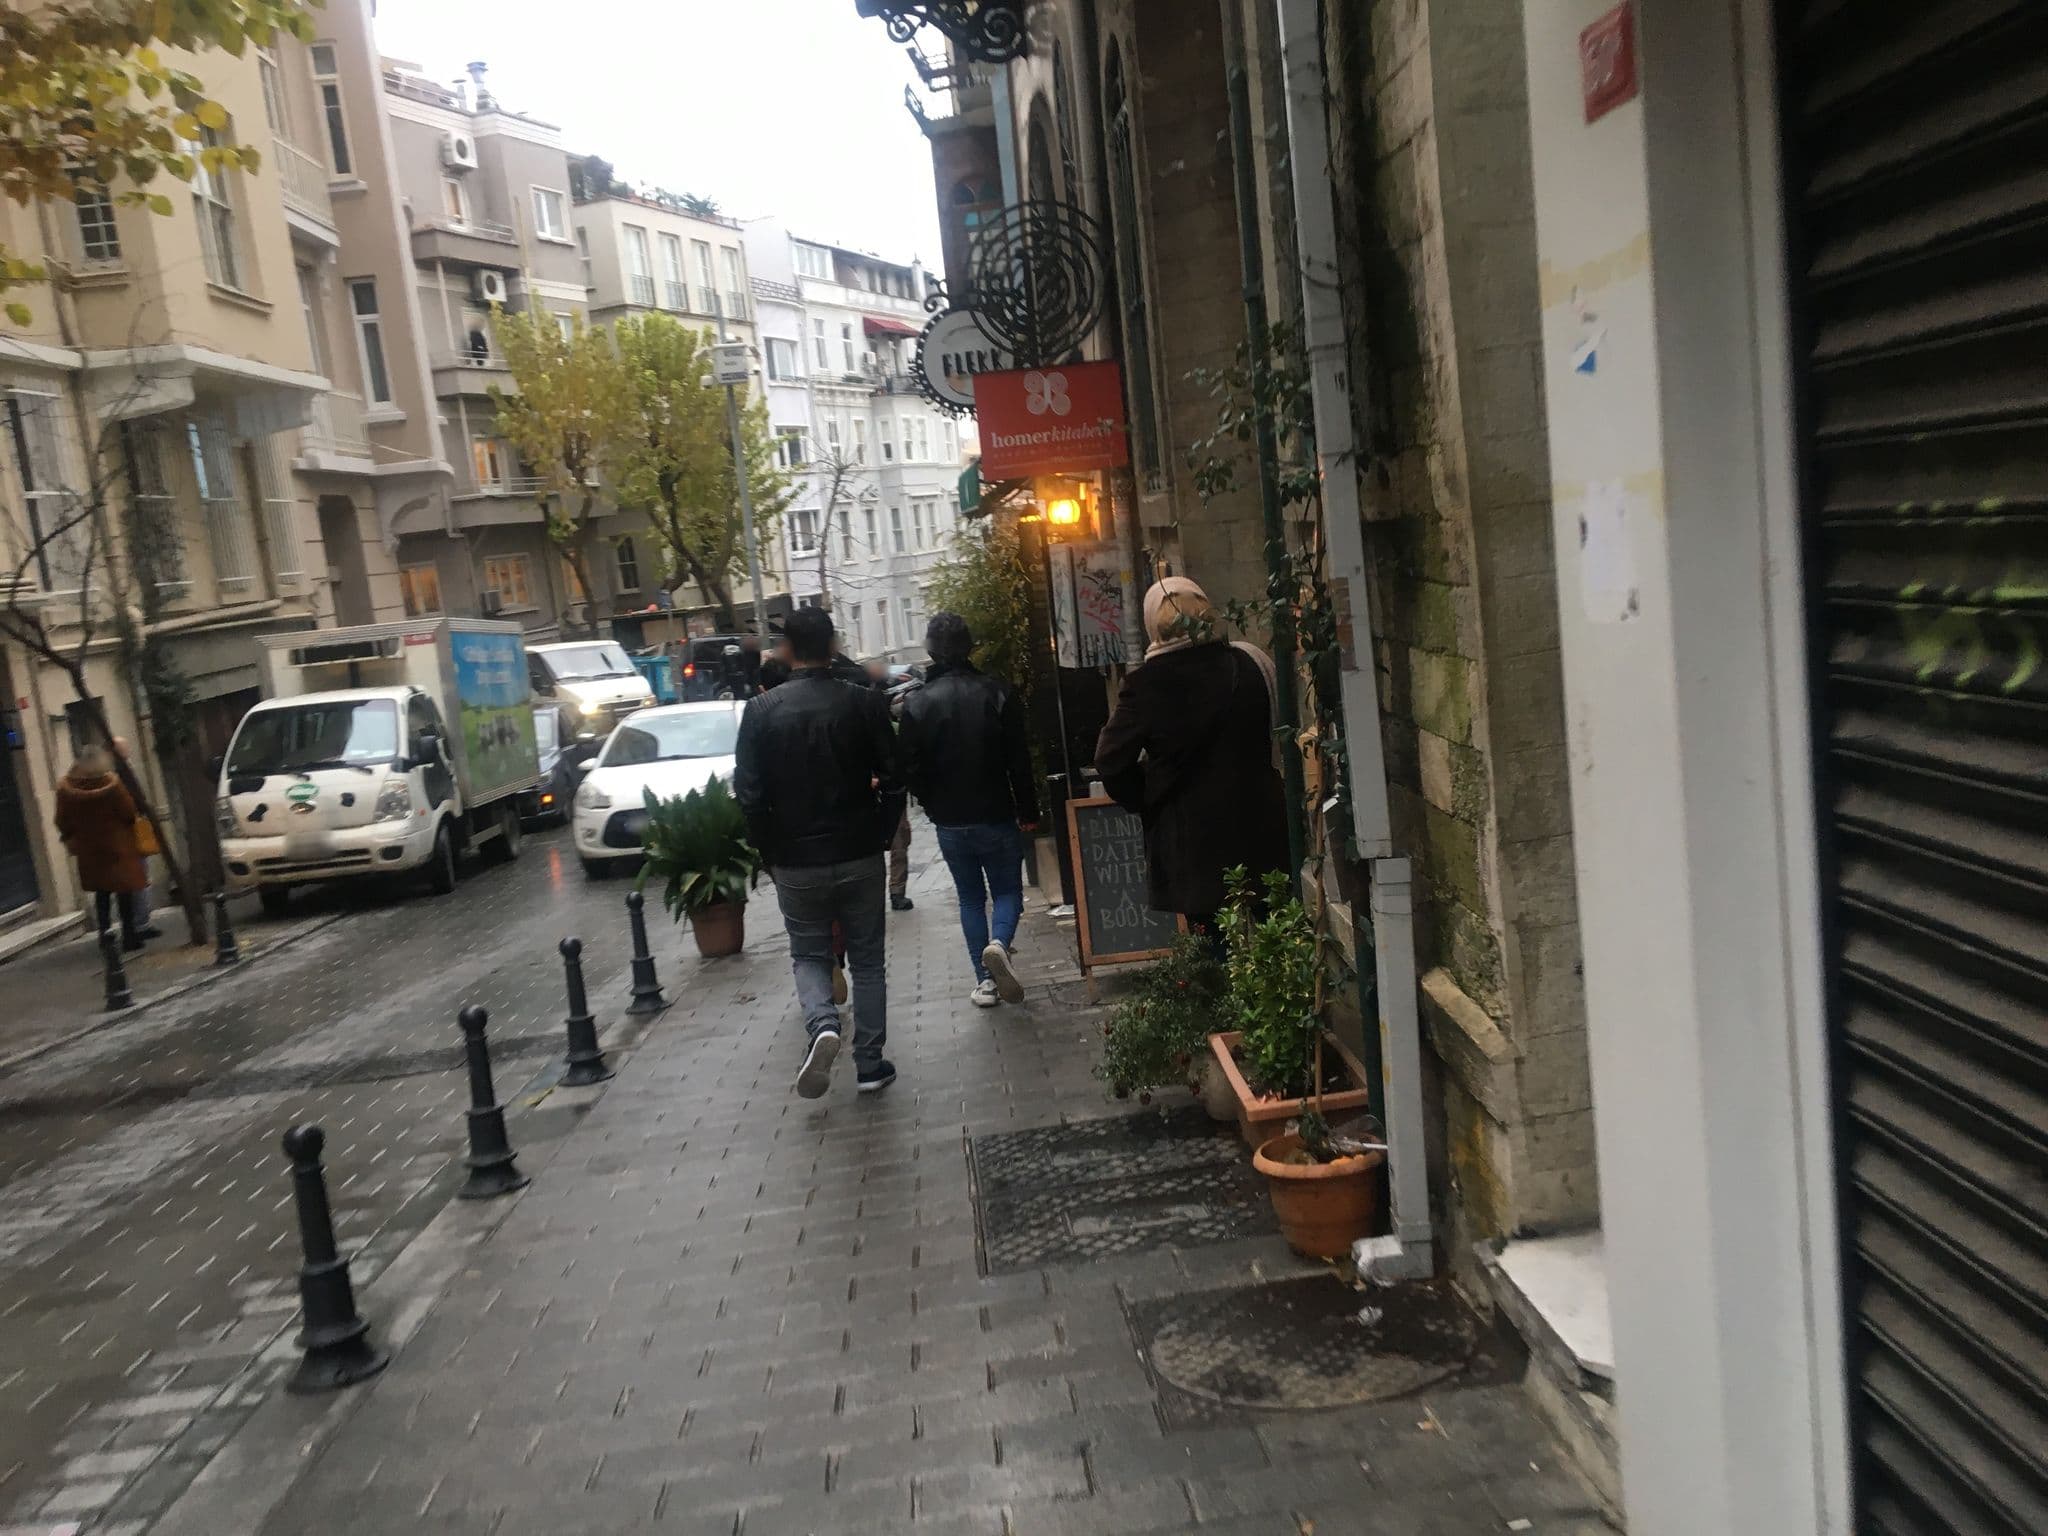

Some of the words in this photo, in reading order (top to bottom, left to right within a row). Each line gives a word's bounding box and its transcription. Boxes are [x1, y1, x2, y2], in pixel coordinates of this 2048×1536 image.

[1089, 814, 1143, 838] BLIND
[1091, 838, 1145, 862] DATE
[1093, 860, 1147, 885] WITH
[1119, 888, 1134, 909] A
[1101, 904, 1159, 929] BOOK
